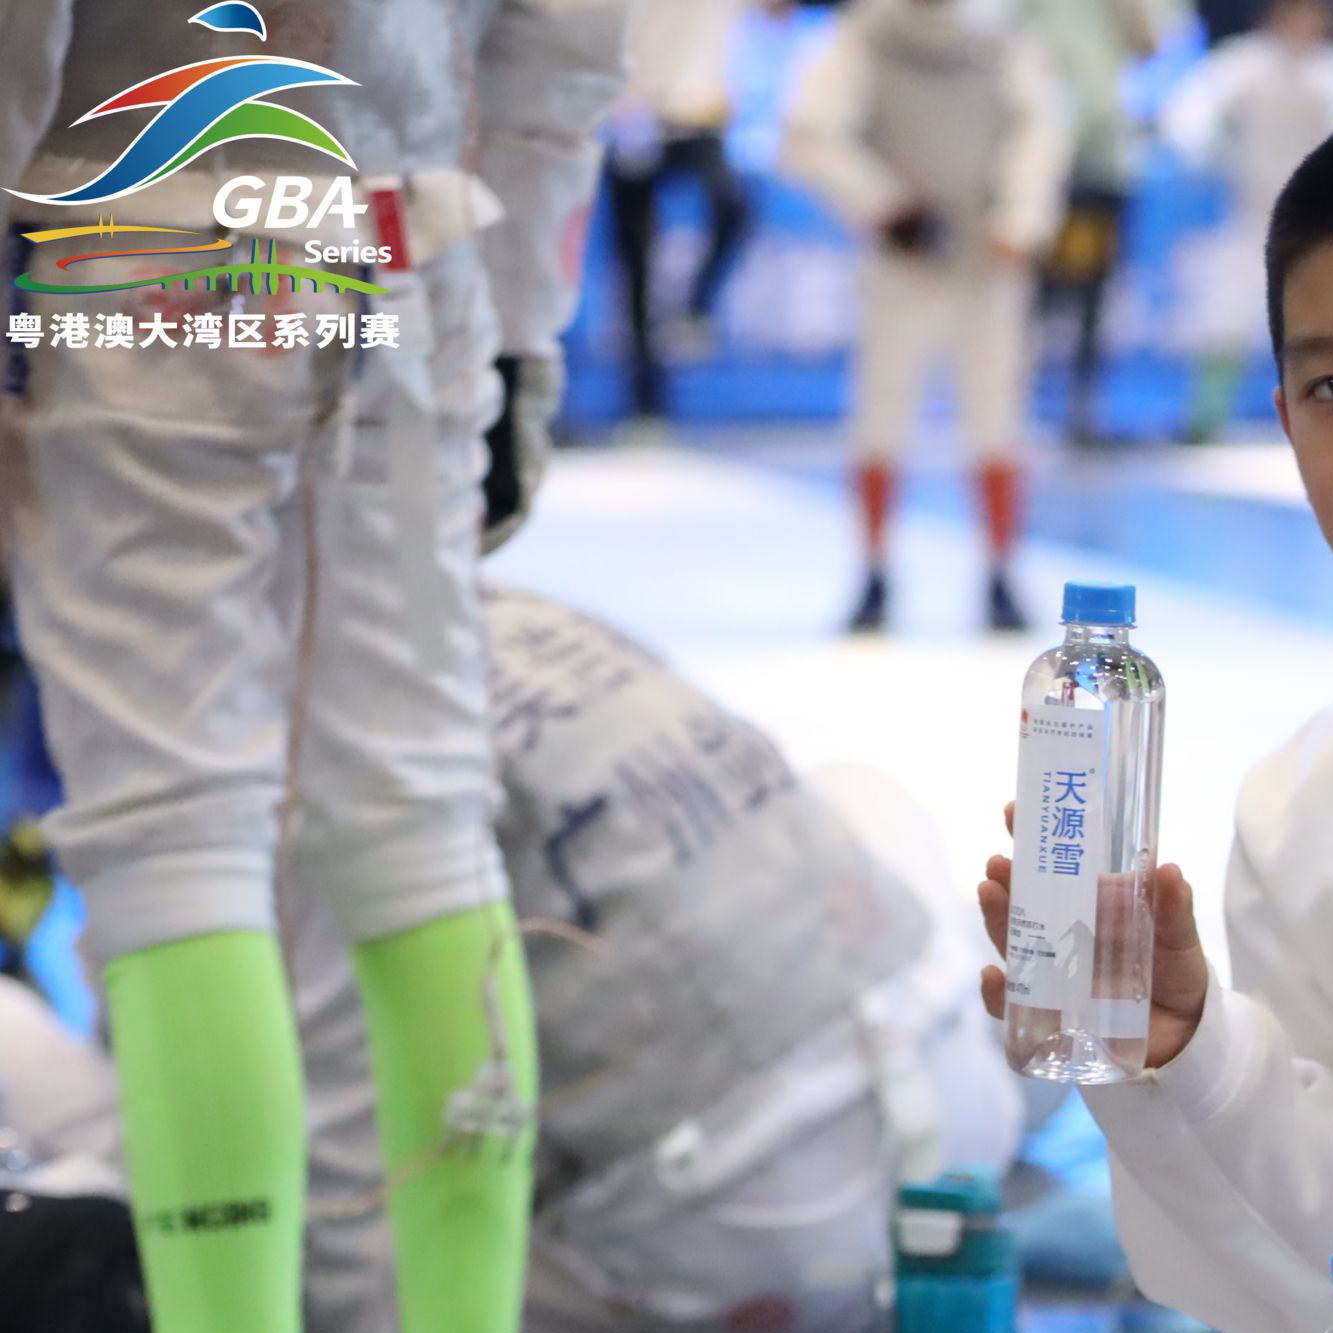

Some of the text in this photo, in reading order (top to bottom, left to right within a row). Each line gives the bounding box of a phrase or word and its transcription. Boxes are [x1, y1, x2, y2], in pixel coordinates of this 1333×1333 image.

[1038, 770, 1051, 873] TIANYUANXUE
[1051, 770, 1087, 876] 天源雪
